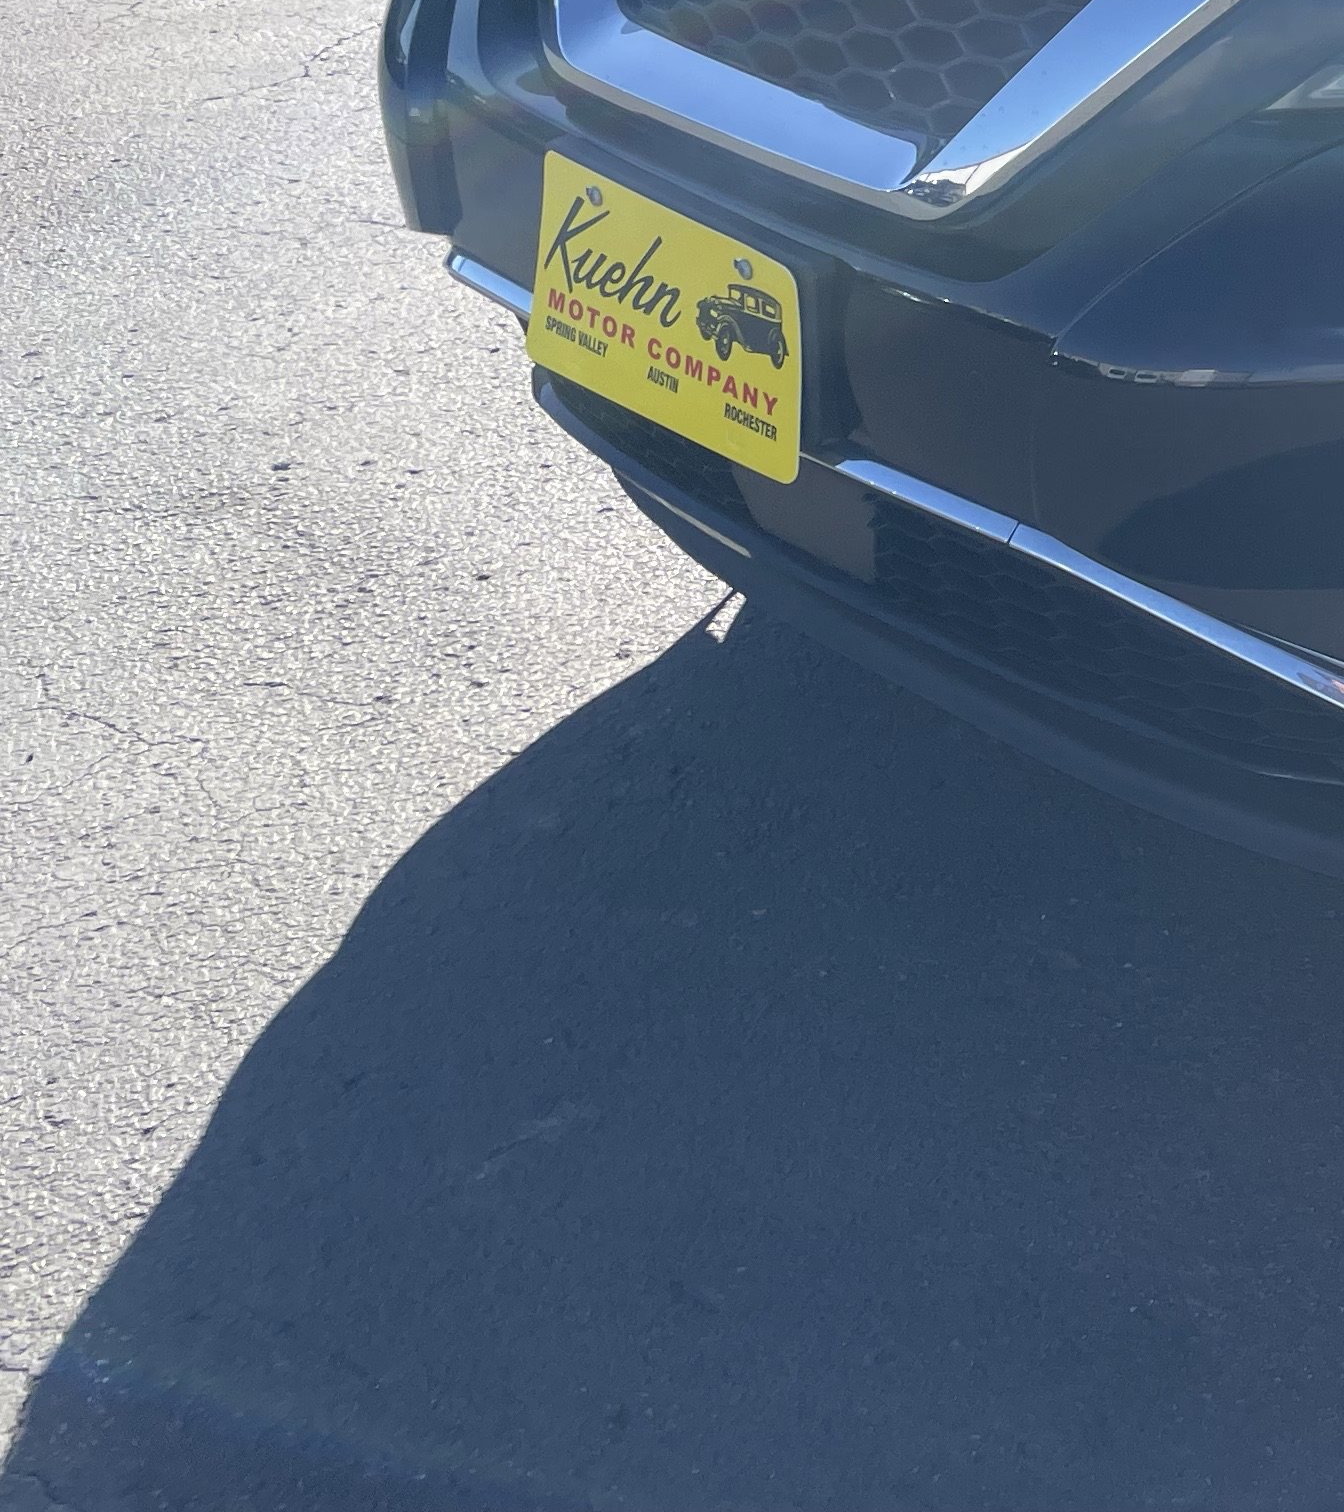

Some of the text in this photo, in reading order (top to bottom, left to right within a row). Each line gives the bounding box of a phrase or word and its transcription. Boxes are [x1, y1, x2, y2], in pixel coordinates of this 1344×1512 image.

[544, 196, 682, 328] Kuehn
[545, 315, 609, 358] SPRING VALLEY
[547, 288, 779, 416] MOTOR COMPANY
[647, 366, 679, 393] AUSTIN
[724, 402, 778, 442] ROCHESTER
